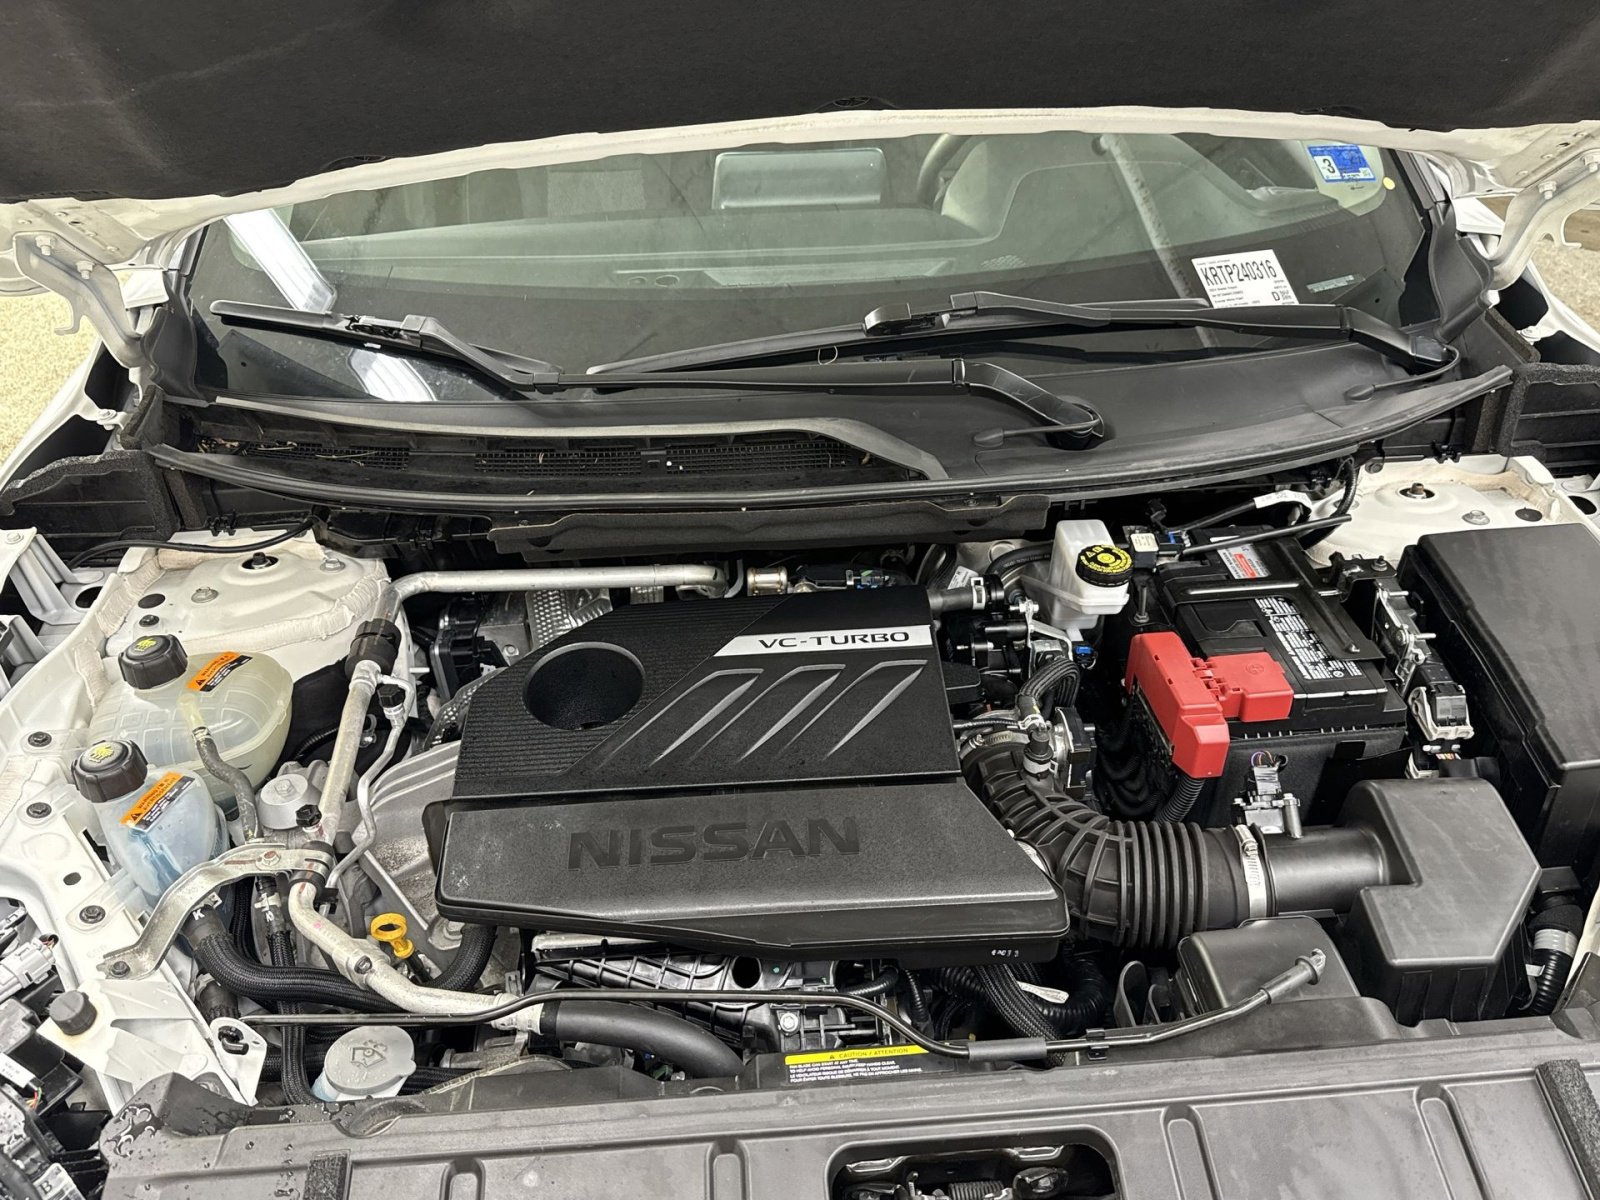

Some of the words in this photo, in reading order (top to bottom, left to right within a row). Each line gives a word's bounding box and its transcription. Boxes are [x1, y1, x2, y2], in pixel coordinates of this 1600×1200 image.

[1323, 158, 1336, 174] 3
[1200, 259, 1277, 286] KRTP240316
[1271, 291, 1280, 302] D
[758, 632, 910, 648] VC-TURBO
[568, 816, 861, 872] NISSAN
[192, 908, 205, 920] K
[40, 1180, 52, 1194] B
